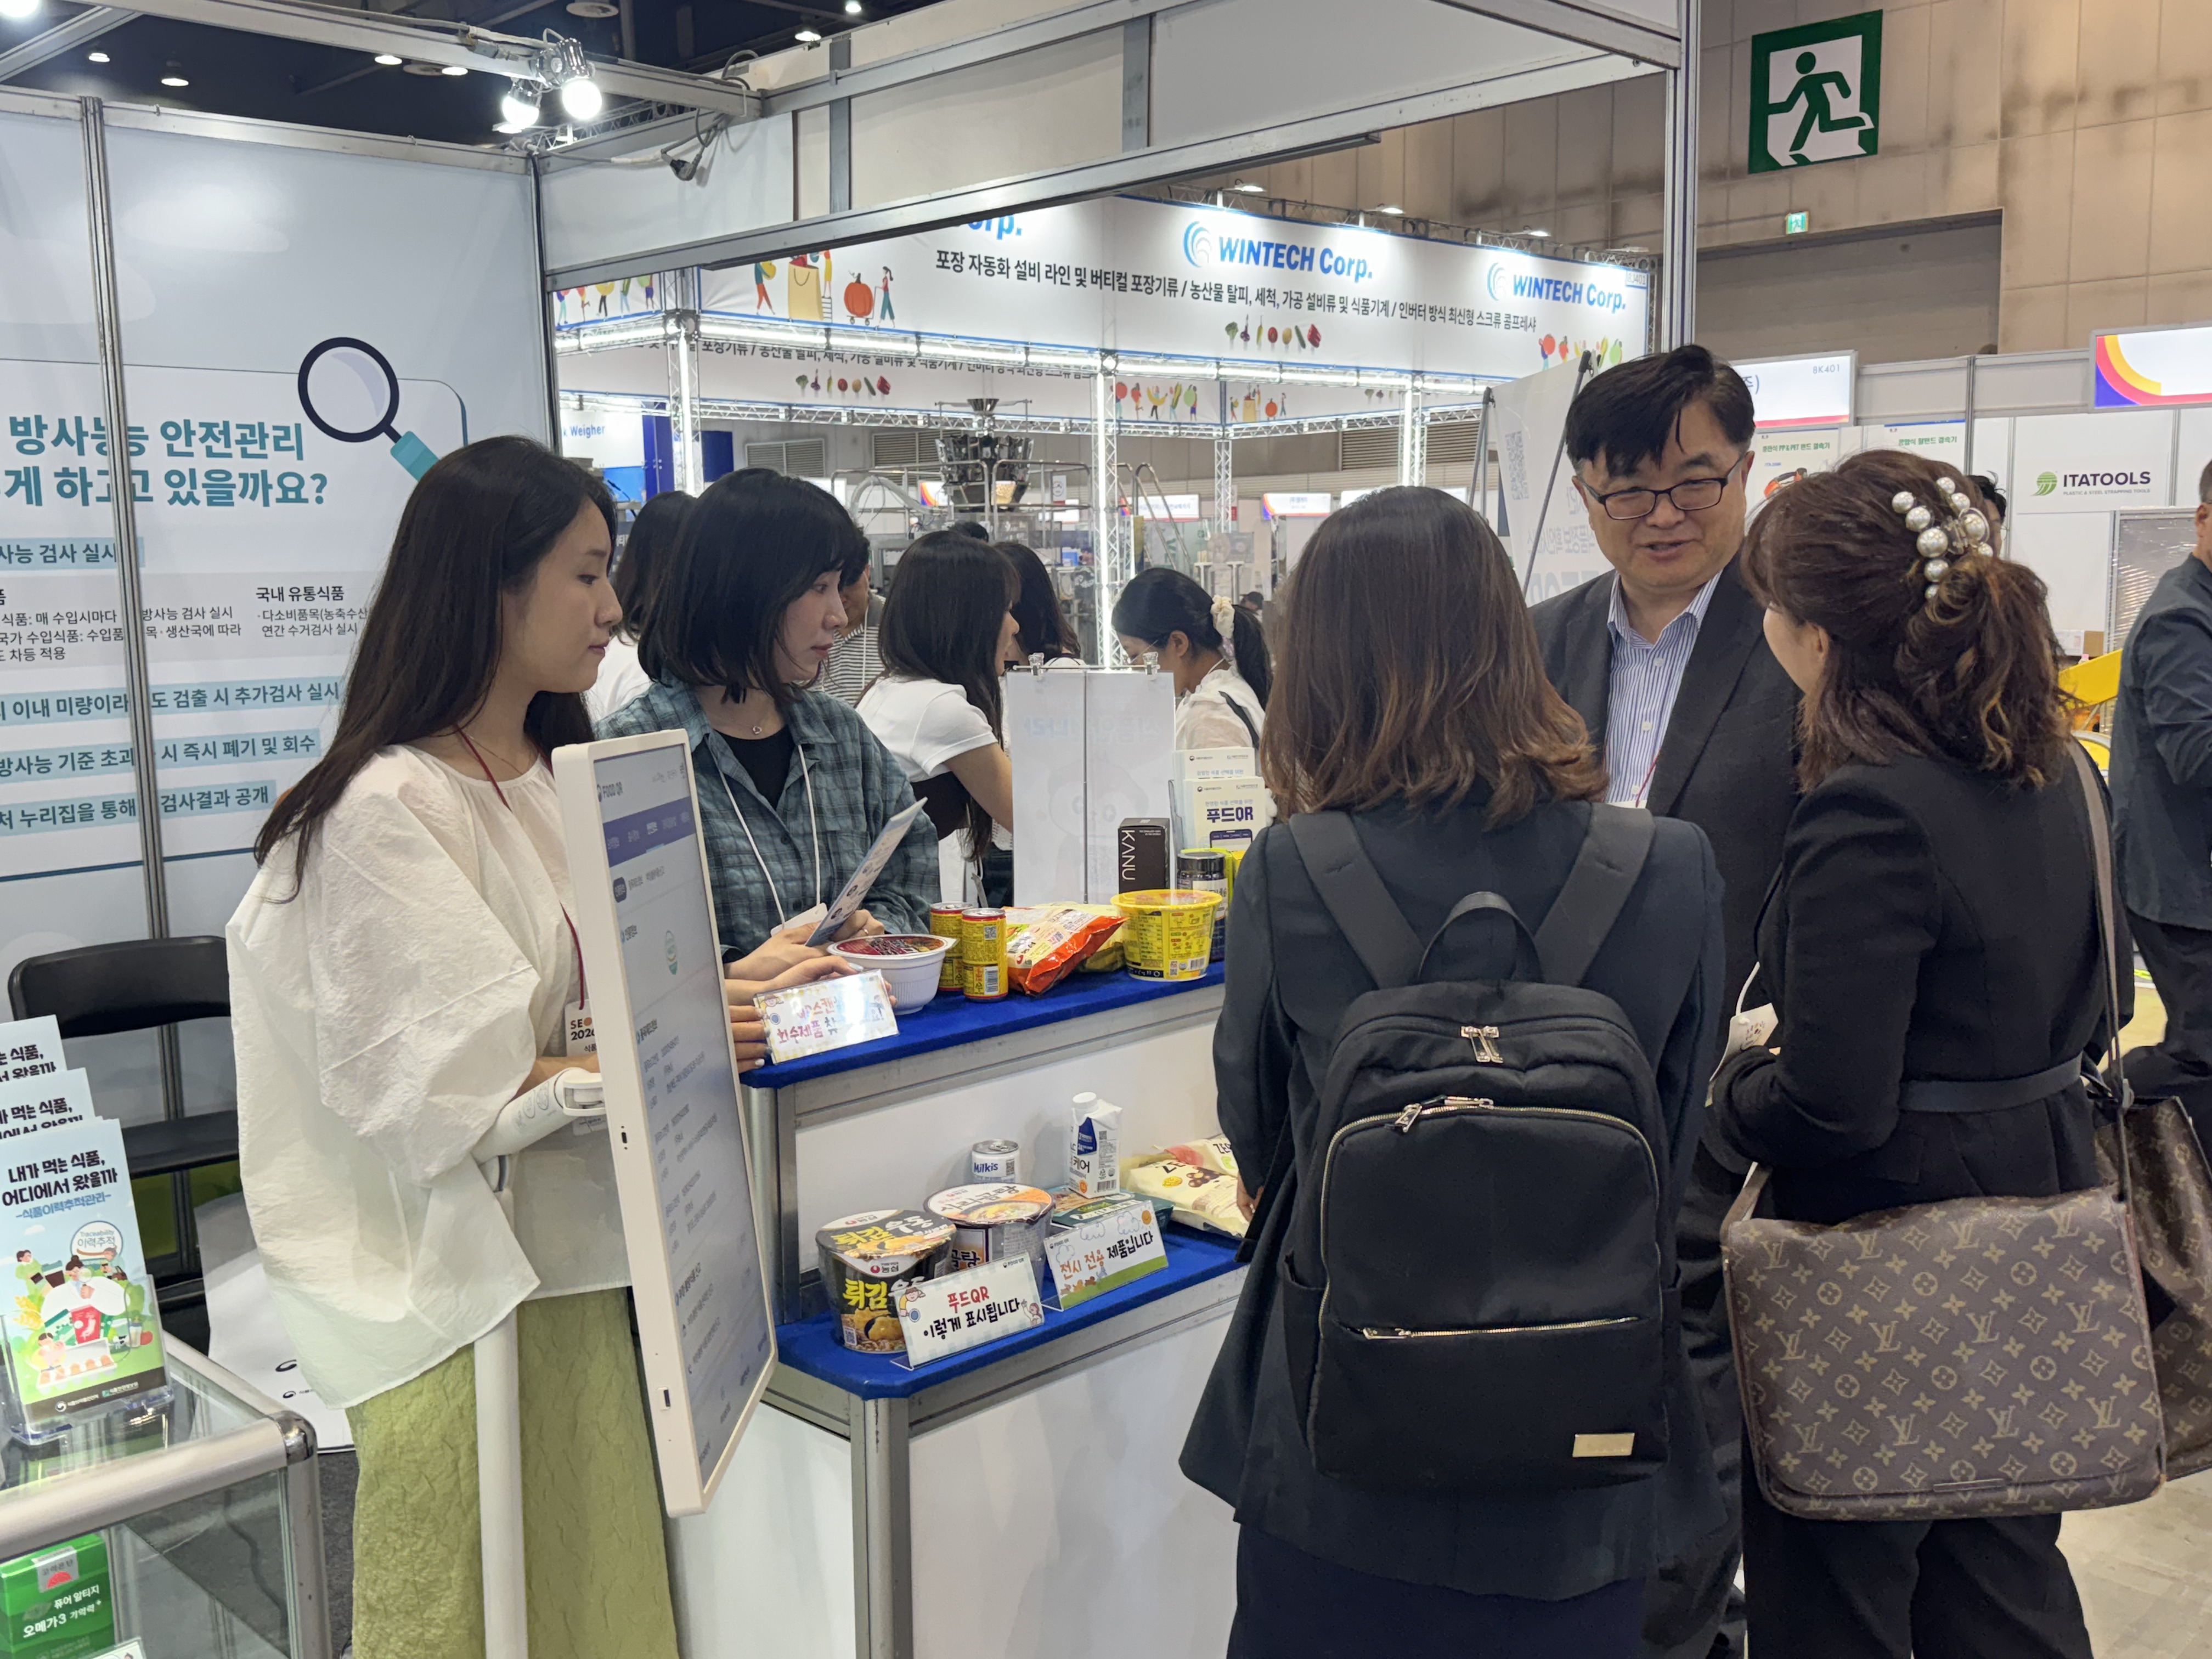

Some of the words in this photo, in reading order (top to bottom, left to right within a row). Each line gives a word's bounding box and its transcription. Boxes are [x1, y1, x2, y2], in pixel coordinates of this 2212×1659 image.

[1219, 236, 1314, 272] WINTECH
[1319, 248, 1373, 283] Corp.
[936, 250, 965, 273] 포장
[968, 254, 1010, 279] 자동화
[1014, 259, 1040, 283] 설비
[1045, 264, 1070, 286] 라인
[1075, 267, 1087, 288] 및
[1091, 269, 1127, 292] 버티컬
[1131, 274, 1178, 297] 포장기류
[1181, 280, 1187, 297] /
[1190, 280, 1223, 302] 농산물
[1227, 285, 1251, 306] 탈피,
[1255, 287, 1280, 309] 세척,
[1283, 290, 1304, 309] 가공
[1306, 292, 1336, 313] 설비류
[1340, 296, 1348, 314] 및
[1351, 297, 1389, 318] 식품기계
[1392, 302, 1396, 317] /
[1399, 302, 1426, 321] 인버터
[1429, 305, 1446, 323] 방식
[1449, 307, 1474, 326] 최신형
[1476, 311, 1501, 329] 스크류
[1513, 274, 1583, 304] WINTECH
[1587, 283, 1626, 314] Corp.
[1813, 364, 1841, 375] 8K401
[9, 415, 149, 456] 방사능
[160, 419, 303, 461] 안전관리
[569, 424, 606, 437] Weigher
[54, 467, 153, 506] 하고
[165, 468, 327, 507] 있을까요?
[2063, 471, 2151, 487] ITATOOLS
[40, 544, 77, 563] 검사
[83, 543, 117, 563] 실시
[256, 586, 284, 602] 국내
[289, 586, 345, 602] 유통식품
[2, 613, 32, 627] 식품:
[36, 612, 48, 625] 매
[52, 610, 117, 624] 수입시마다
[142, 607, 178, 622] 방사능
[182, 607, 206, 620] 검사
[209, 606, 233, 619] 실시
[26, 629, 83, 644] 수입식품:
[166, 624, 215, 639] 생산국에
[217, 623, 241, 636] 따라
[262, 624, 285, 637] 연간
[288, 623, 332, 636] 수거검사
[336, 623, 358, 635] 실시
[10, 648, 36, 662] 차등
[40, 646, 66, 661] 적용
[13, 698, 50, 719] 이내
[173, 689, 207, 708] 검출
[213, 687, 229, 706] 시
[235, 684, 302, 704] 추가검사
[307, 682, 339, 701] 실시
[0, 755, 53, 777] 방사능
[58, 752, 95, 771] 기준
[161, 744, 178, 762] 시
[184, 741, 217, 760] 즉시
[223, 738, 256, 758] 폐기
[262, 737, 278, 755] 및
[283, 735, 315, 753] 회수
[20, 803, 95, 828] 누리집을
[100, 798, 137, 819] 통해
[161, 789, 230, 813] 검사결과
[235, 785, 269, 805] 공개
[1207, 806, 1254, 823] 푸드QR
[1121, 830, 1135, 880] KANU
[10, 1044, 43, 1061] 식품,
[11, 1104, 37, 1121] 먹는
[39, 1098, 72, 1115] 식품,
[8, 1163, 40, 1183] 내가
[42, 1158, 68, 1175] 먹는
[71, 1150, 105, 1168] 식품,
[973, 1162, 998, 1173] Milkis
[2, 1178, 70, 1206] 어디에서
[73, 1168, 118, 1191] 왔을까
[77, 1236, 115, 1248] 이력추적
[1060, 1260, 1082, 1280] 전시
[1084, 1249, 1105, 1270] 전용
[1107, 1231, 1154, 1259] 제품입니다
[843, 1278, 888, 1310] 튀김
[947, 1286, 990, 1313] 푸드QR
[924, 1317, 962, 1340] 이렇게
[966, 1297, 1020, 1328] 표시됩니다
[54, 1595, 72, 1609] 퓨어
[73, 1584, 99, 1602] 알티지
[23, 1613, 66, 1638] 오메가3
